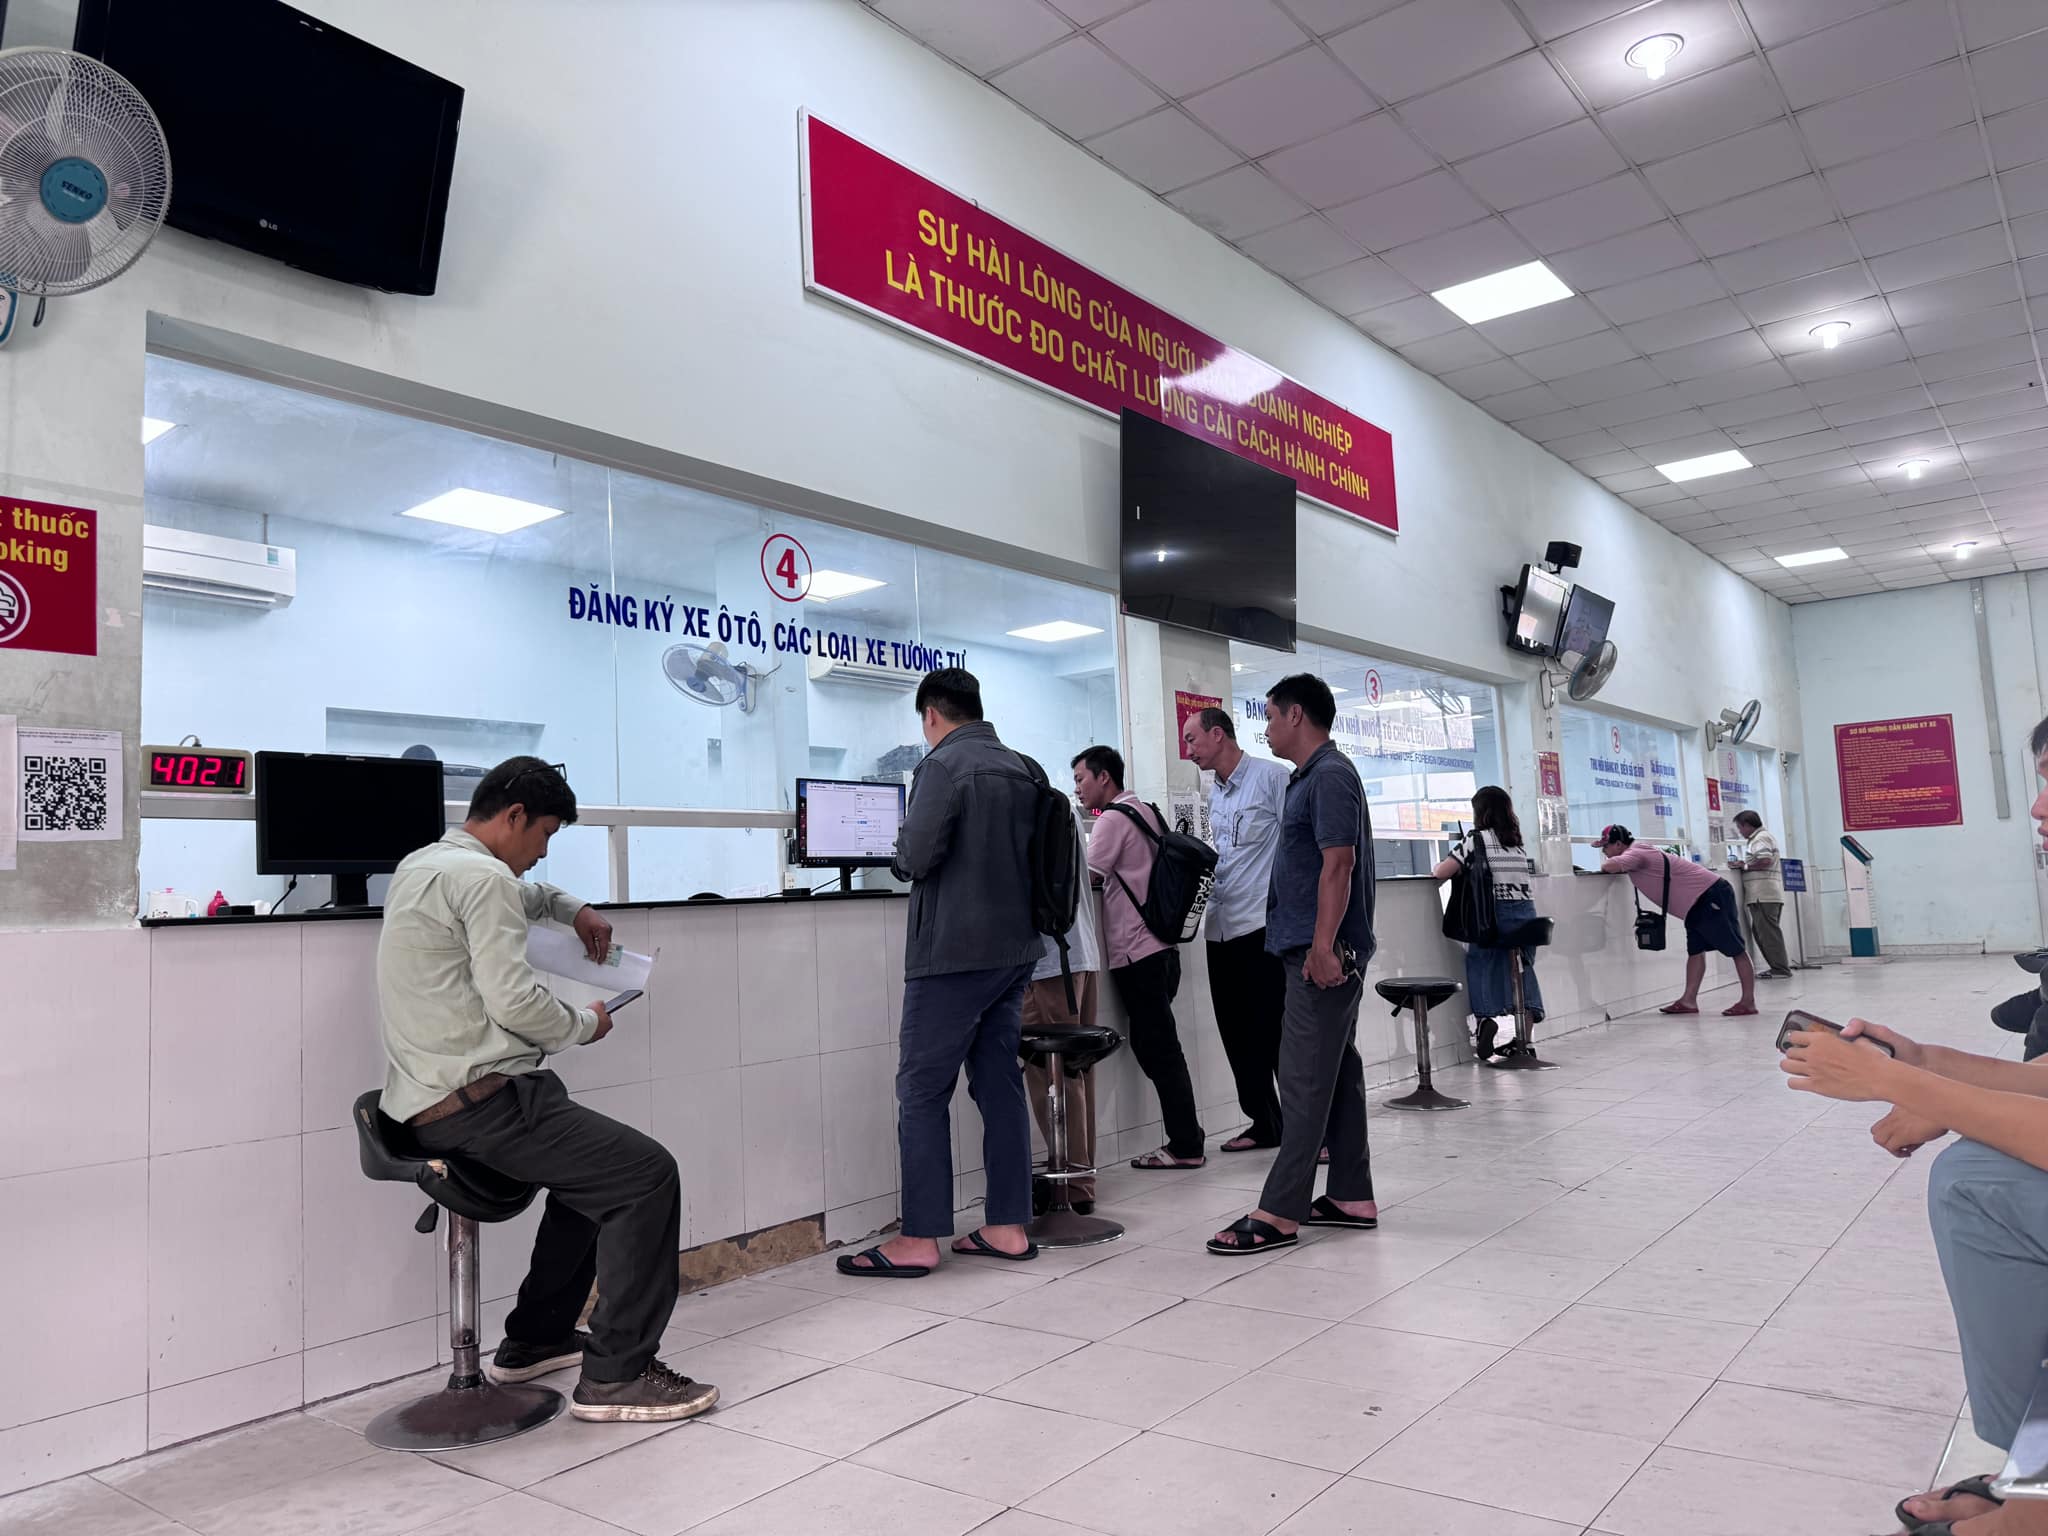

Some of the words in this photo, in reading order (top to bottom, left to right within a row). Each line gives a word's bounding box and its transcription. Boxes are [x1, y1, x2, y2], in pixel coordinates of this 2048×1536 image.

[918, 208, 959, 263] SỰ
[967, 232, 1011, 286] HÀI
[1018, 260, 1082, 321] LÒNG
[1089, 301, 1133, 348] CỦA
[1137, 323, 1196, 376] NGƯỜI
[885, 248, 925, 300] LÀ
[929, 269, 1022, 344] THƯỚC
[1029, 319, 1065, 363] ĐO
[1071, 340, 1127, 393] CHẤT
[1203, 402, 1233, 441] CẢI
[1237, 419, 1281, 462] CÁCH
[1284, 440, 1326, 482] HÀNH
[1328, 461, 1370, 501] CHÍNH
[1302, 409, 1353, 457] NGHIỆP
[12, 507, 89, 539] thuốc
[776, 547, 799, 589] 4
[569, 583, 638, 629] ĐĂNG
[644, 595, 675, 633] KÝ
[682, 604, 711, 639] XE
[774, 618, 812, 656] CÁC
[816, 629, 858, 667] LOẠI
[865, 637, 888, 667] XE
[890, 639, 943, 673] TƯƠNG
[1370, 677, 1378, 700] 3
[154, 756, 244, 785] 4021
